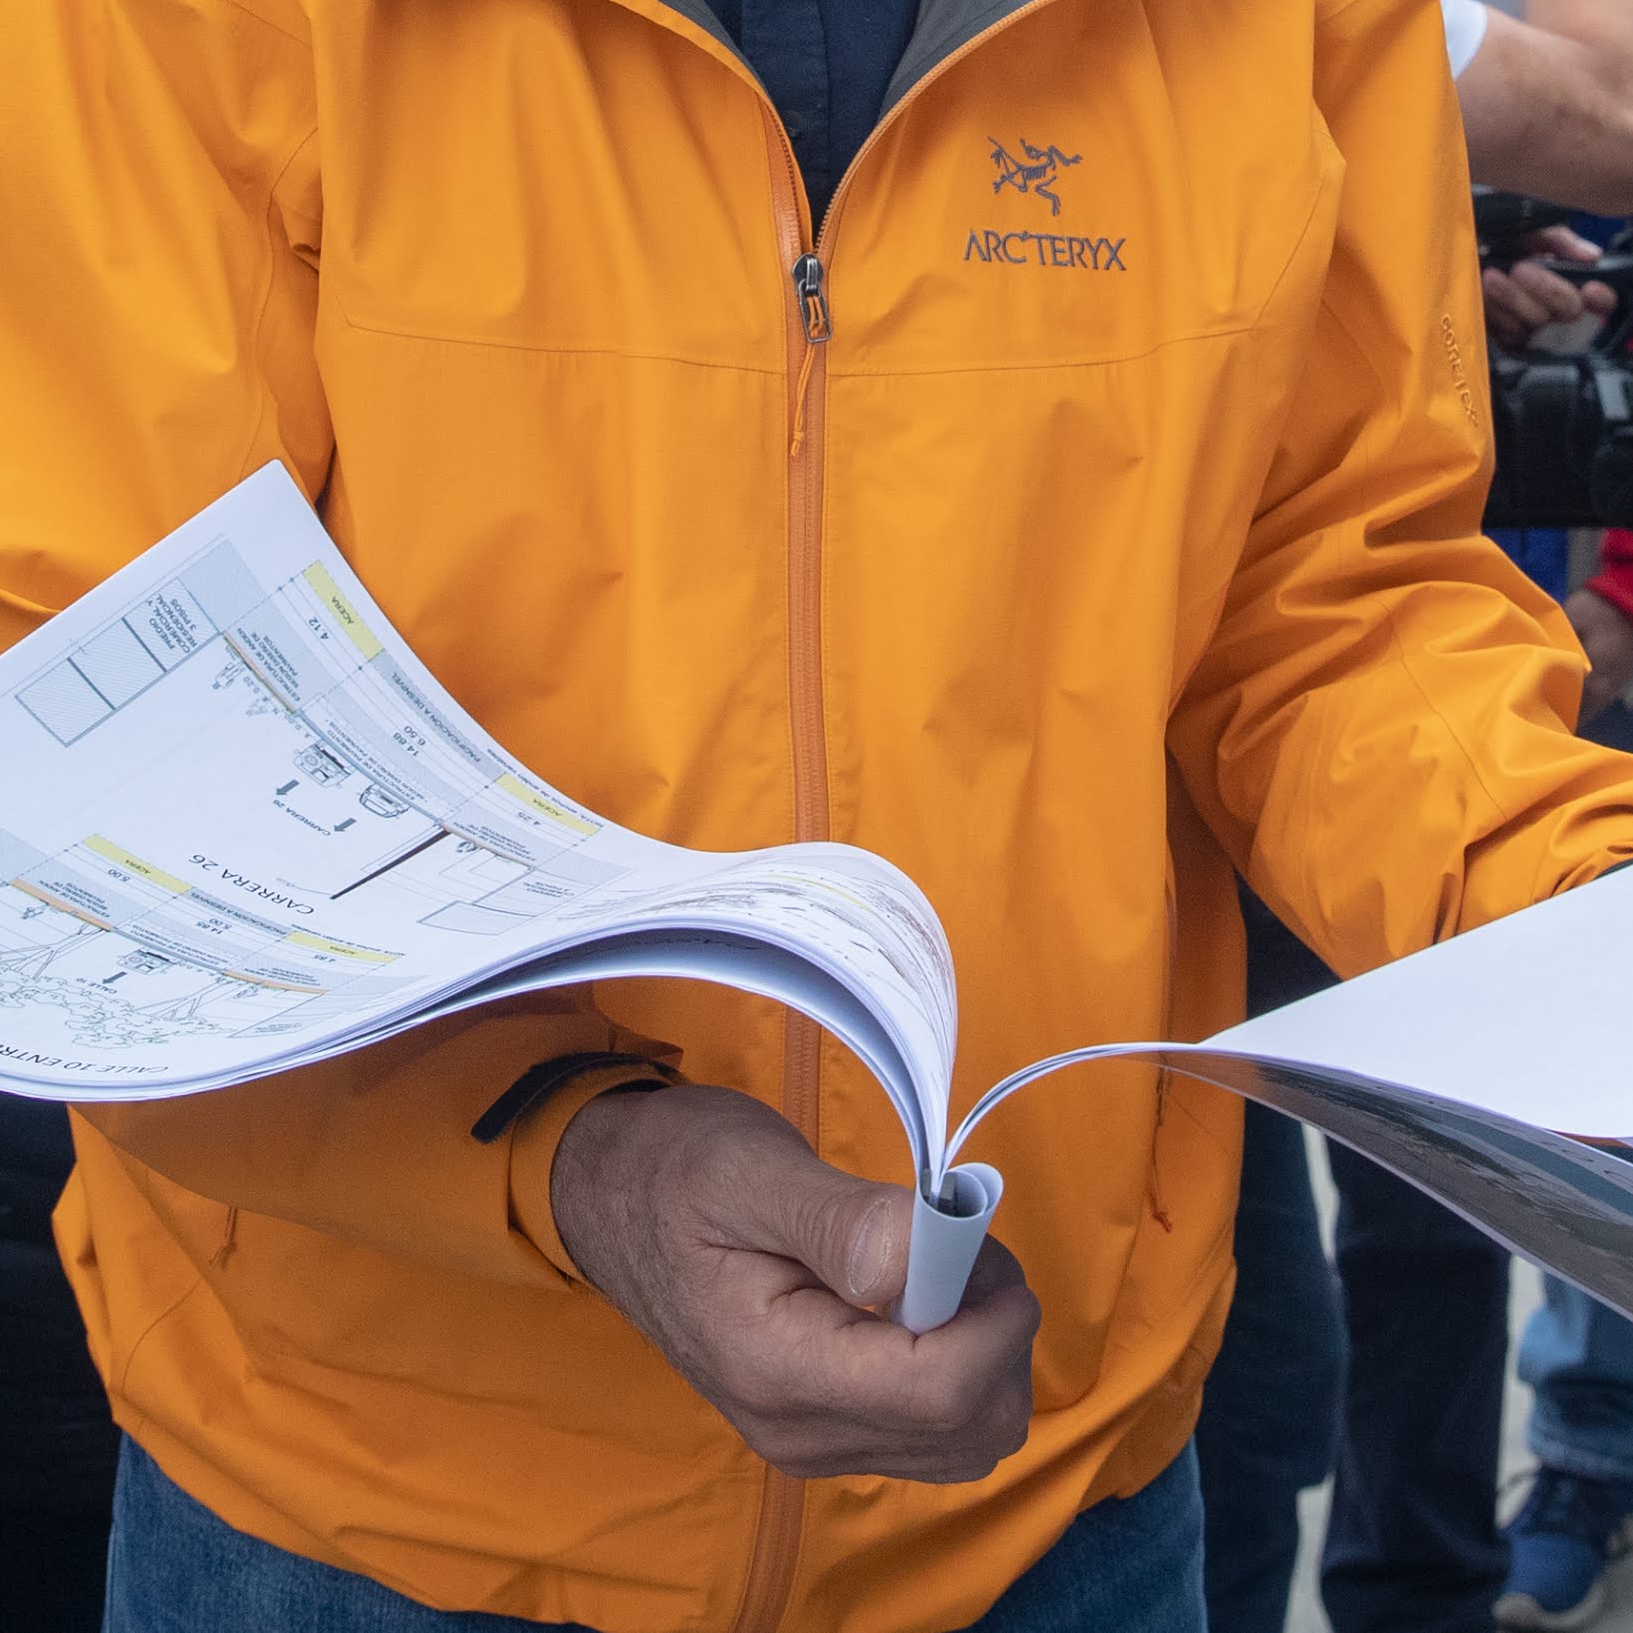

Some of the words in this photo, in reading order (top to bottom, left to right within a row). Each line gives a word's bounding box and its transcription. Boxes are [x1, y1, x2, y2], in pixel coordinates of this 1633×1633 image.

[145, 596, 157, 607] Y
[170, 598, 191, 625] PISOS
[332, 596, 354, 624] ACERA
[153, 606, 190, 653] COMERCIAL
[156, 594, 197, 647] RESIDENCIAL
[309, 617, 329, 639] 4.12
[149, 618, 175, 649] PREDIO
[237, 628, 257, 650] ANDEN
[255, 651, 265, 661] DE
[263, 635, 298, 676] PAVIMENTOS
[264, 660, 300, 702] ESTRUCTURA
[392, 672, 425, 709] DESNIVEL
[423, 705, 431, 714] A
[393, 732, 419, 756] 14.88
[404, 726, 426, 746] 6.50
[533, 798, 562, 816] ACERA
[286, 807, 331, 836] CARRERA
[518, 812, 541, 825] 4.25
[125, 859, 151, 874] ACERA
[189, 855, 219, 870] 26
[107, 869, 131, 882] 5.00
[221, 869, 314, 914] CARRERA
[196, 922, 223, 934] 14.85
[209, 918, 232, 930] 5.00
[63, 1062, 96, 1070] 10
[94, 1064, 168, 1073] CALLE
